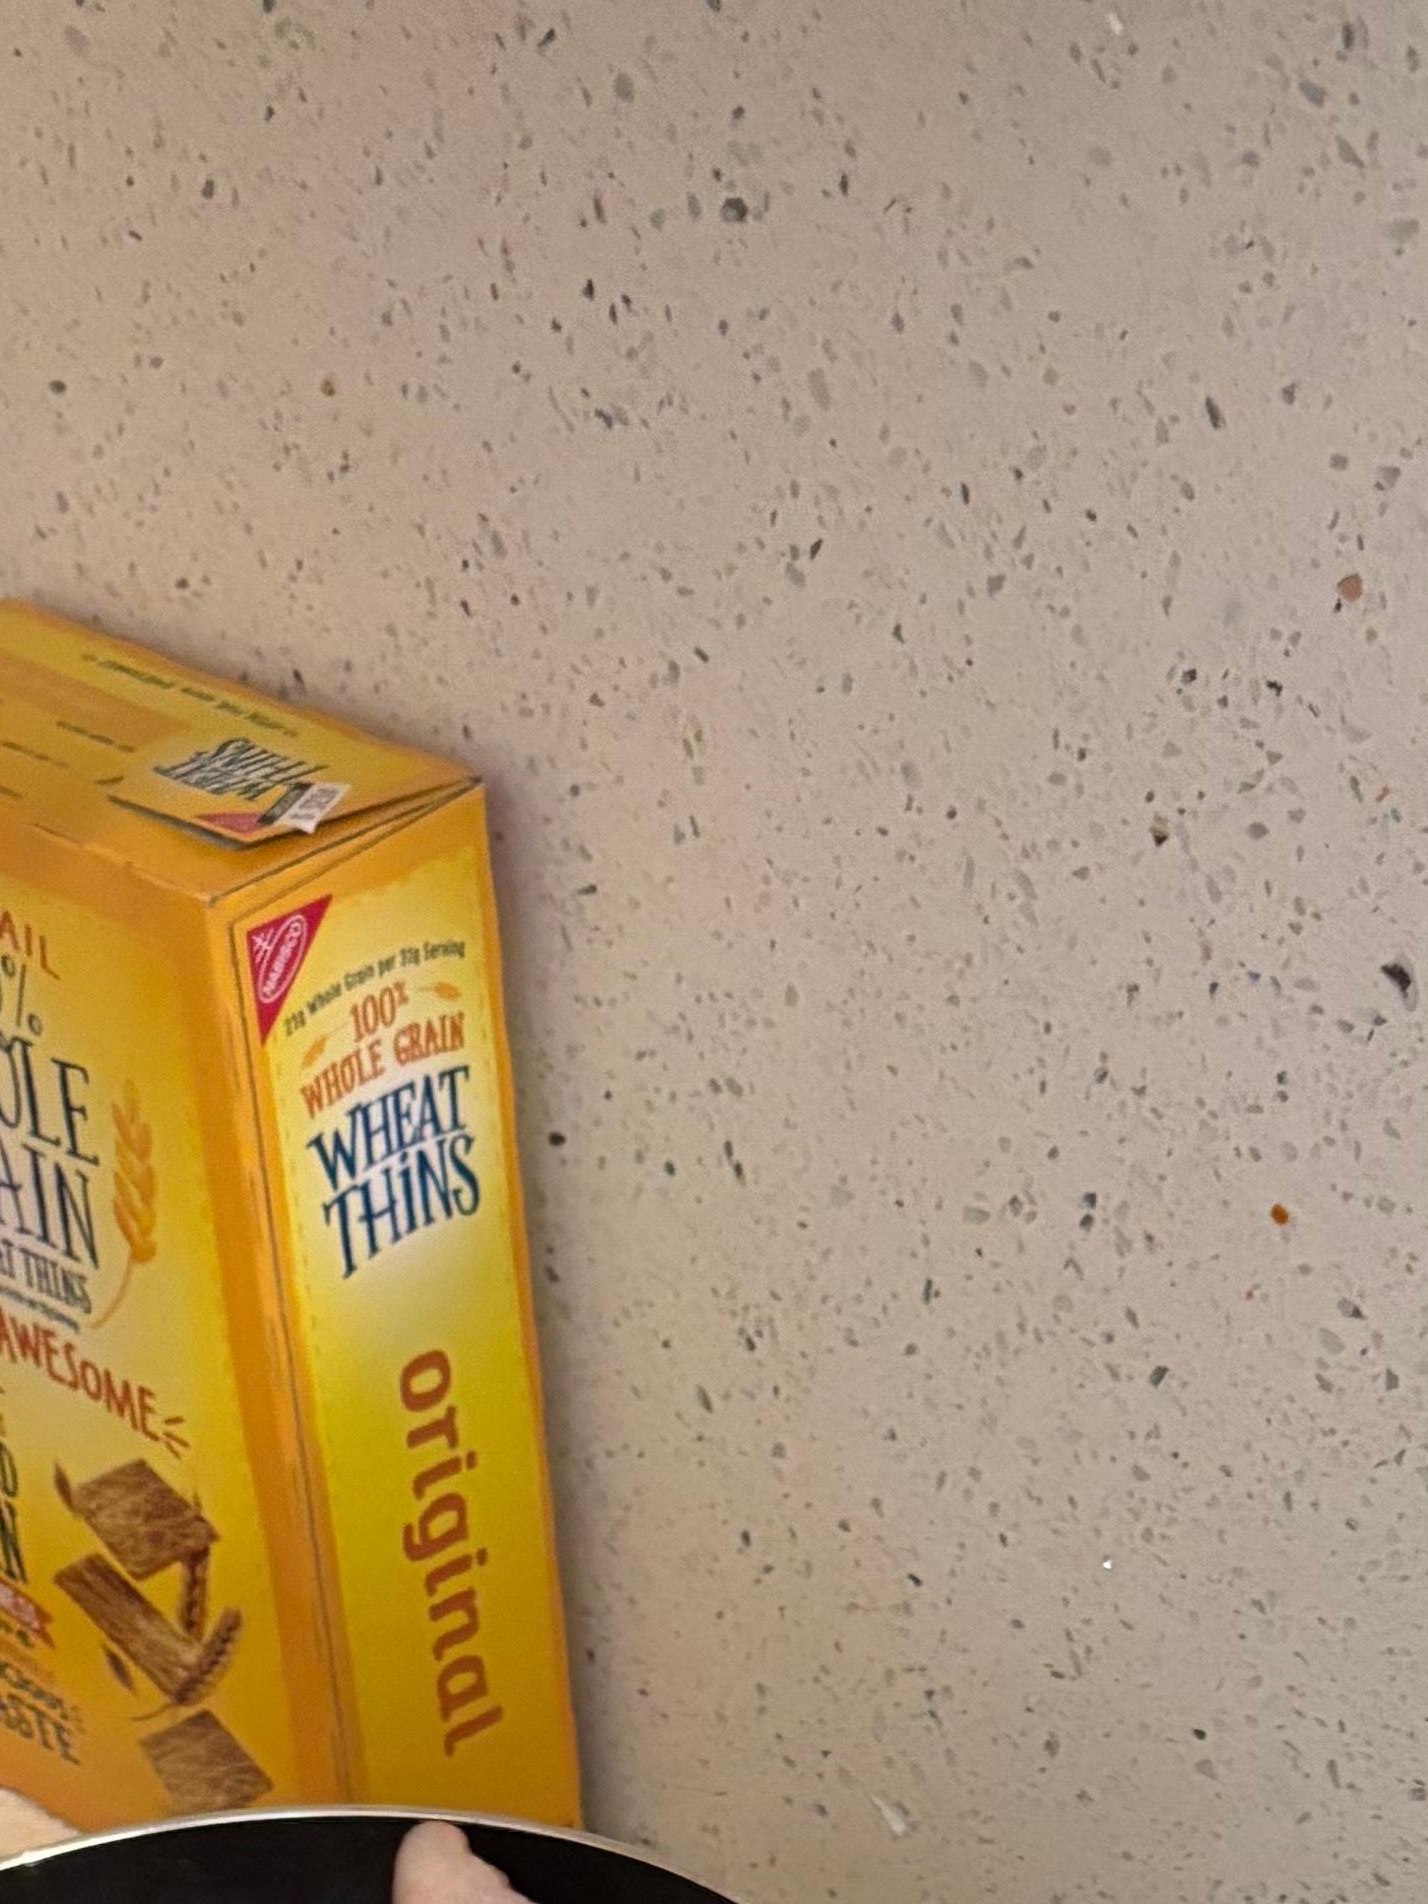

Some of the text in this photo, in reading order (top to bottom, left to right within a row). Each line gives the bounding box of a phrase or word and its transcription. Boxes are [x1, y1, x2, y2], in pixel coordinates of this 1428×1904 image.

[300, 1010, 465, 1120] WHOLE GRAIN
[349, 979, 410, 1044] 100%
[307, 1064, 470, 1192] WHEAT
[398, 1348, 504, 1759] original
